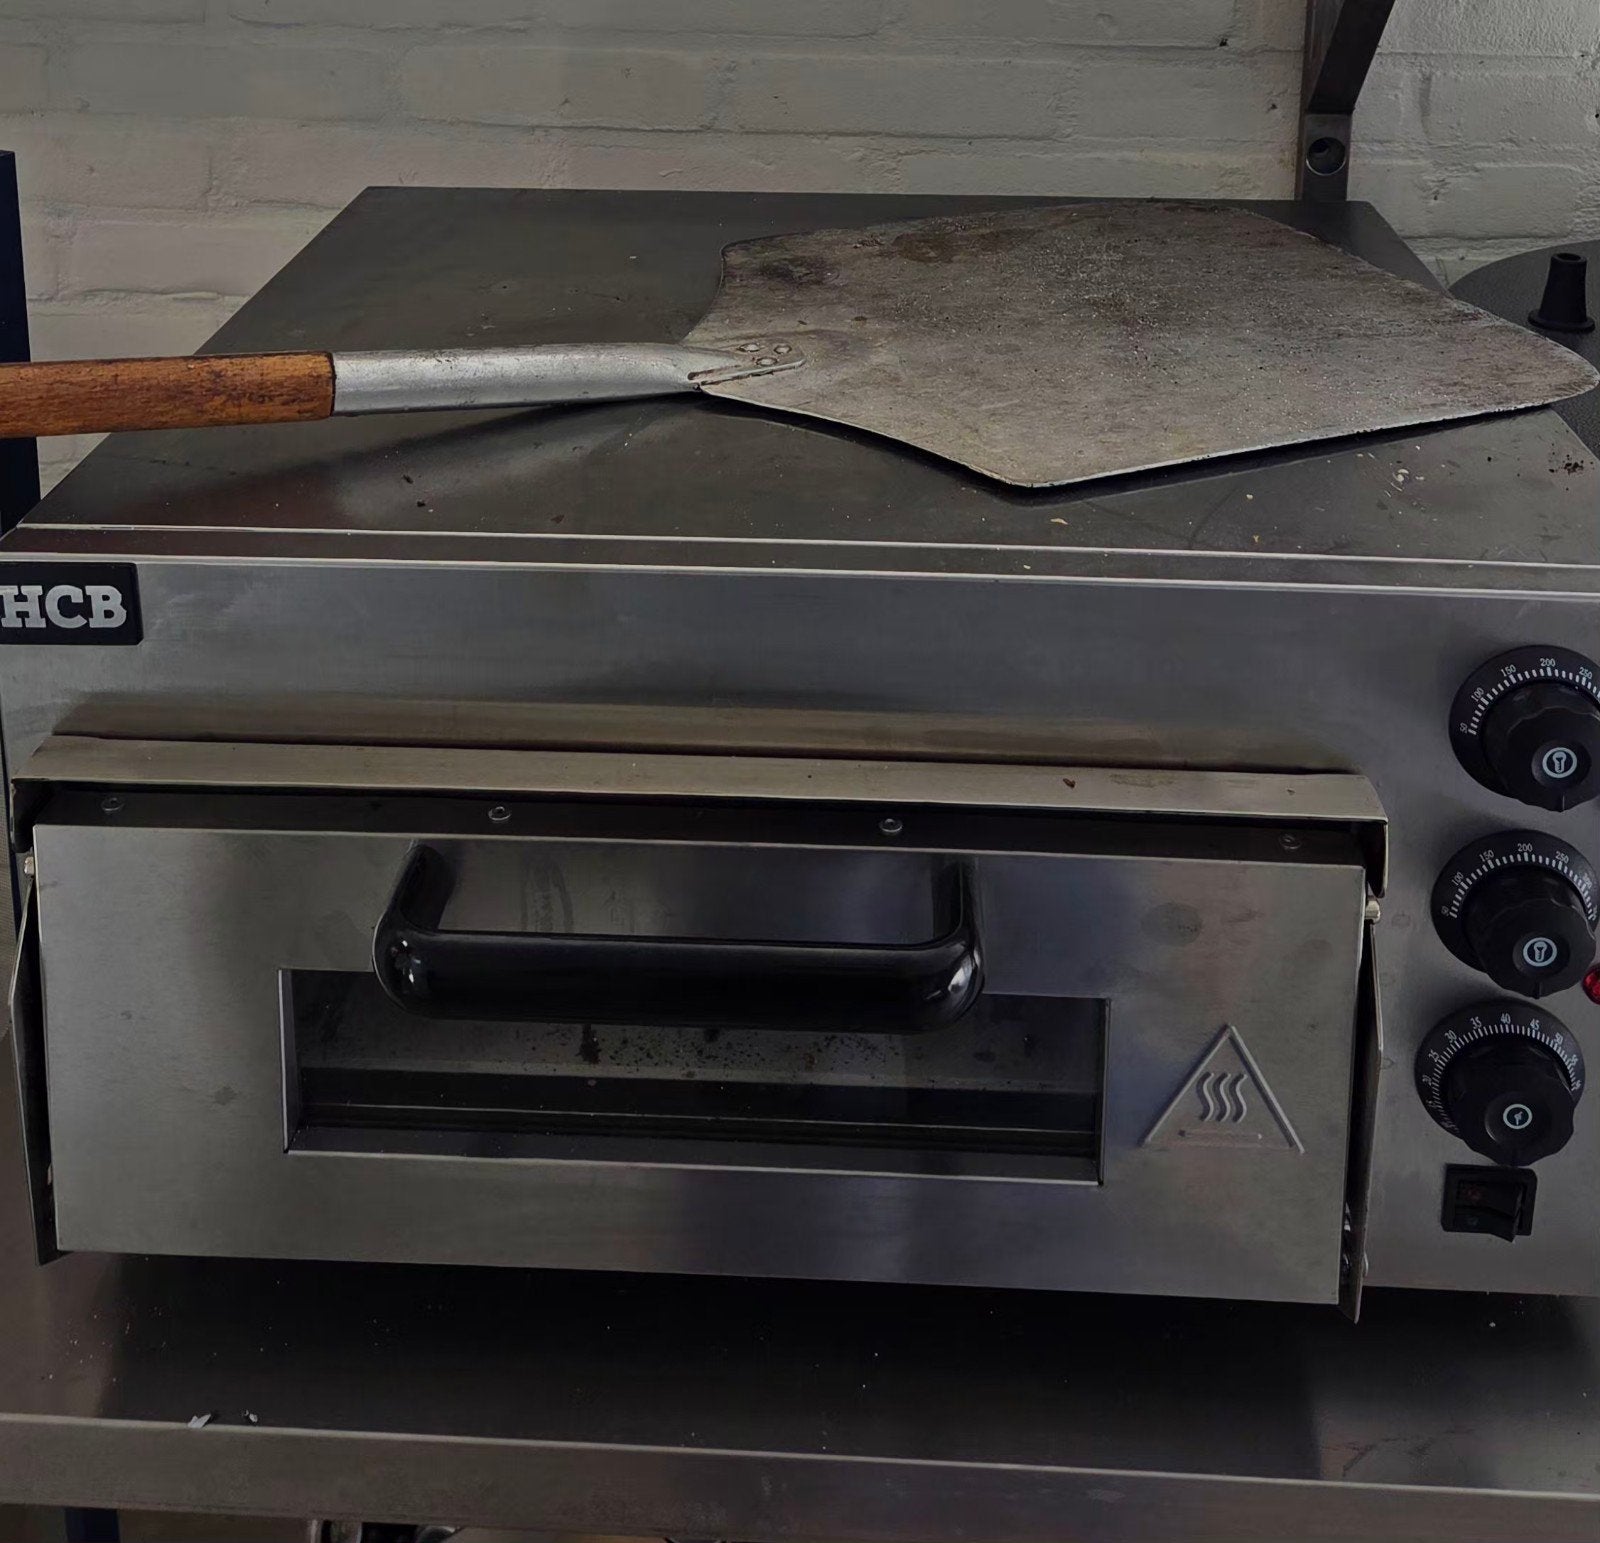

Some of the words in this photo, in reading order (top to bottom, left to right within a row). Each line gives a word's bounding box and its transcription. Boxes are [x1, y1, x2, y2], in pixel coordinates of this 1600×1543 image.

[0, 585, 127, 629] HCB
[1459, 722, 1468, 734] 50
[1470, 687, 1485, 702] 100
[1500, 664, 1517, 677] 150
[1539, 658, 1556, 667] 200
[1579, 667, 1593, 680] 250
[1451, 871, 1464, 887] 100
[1479, 849, 1495, 863] 150
[1517, 843, 1533, 852] 200
[1555, 851, 1569, 864] 250
[1428, 1049, 1440, 1062] 25
[1444, 1029, 1457, 1043] 30
[1470, 1016, 1483, 1029] 35
[1500, 1013, 1511, 1024] 40
[1529, 1018, 1540, 1030] 45
